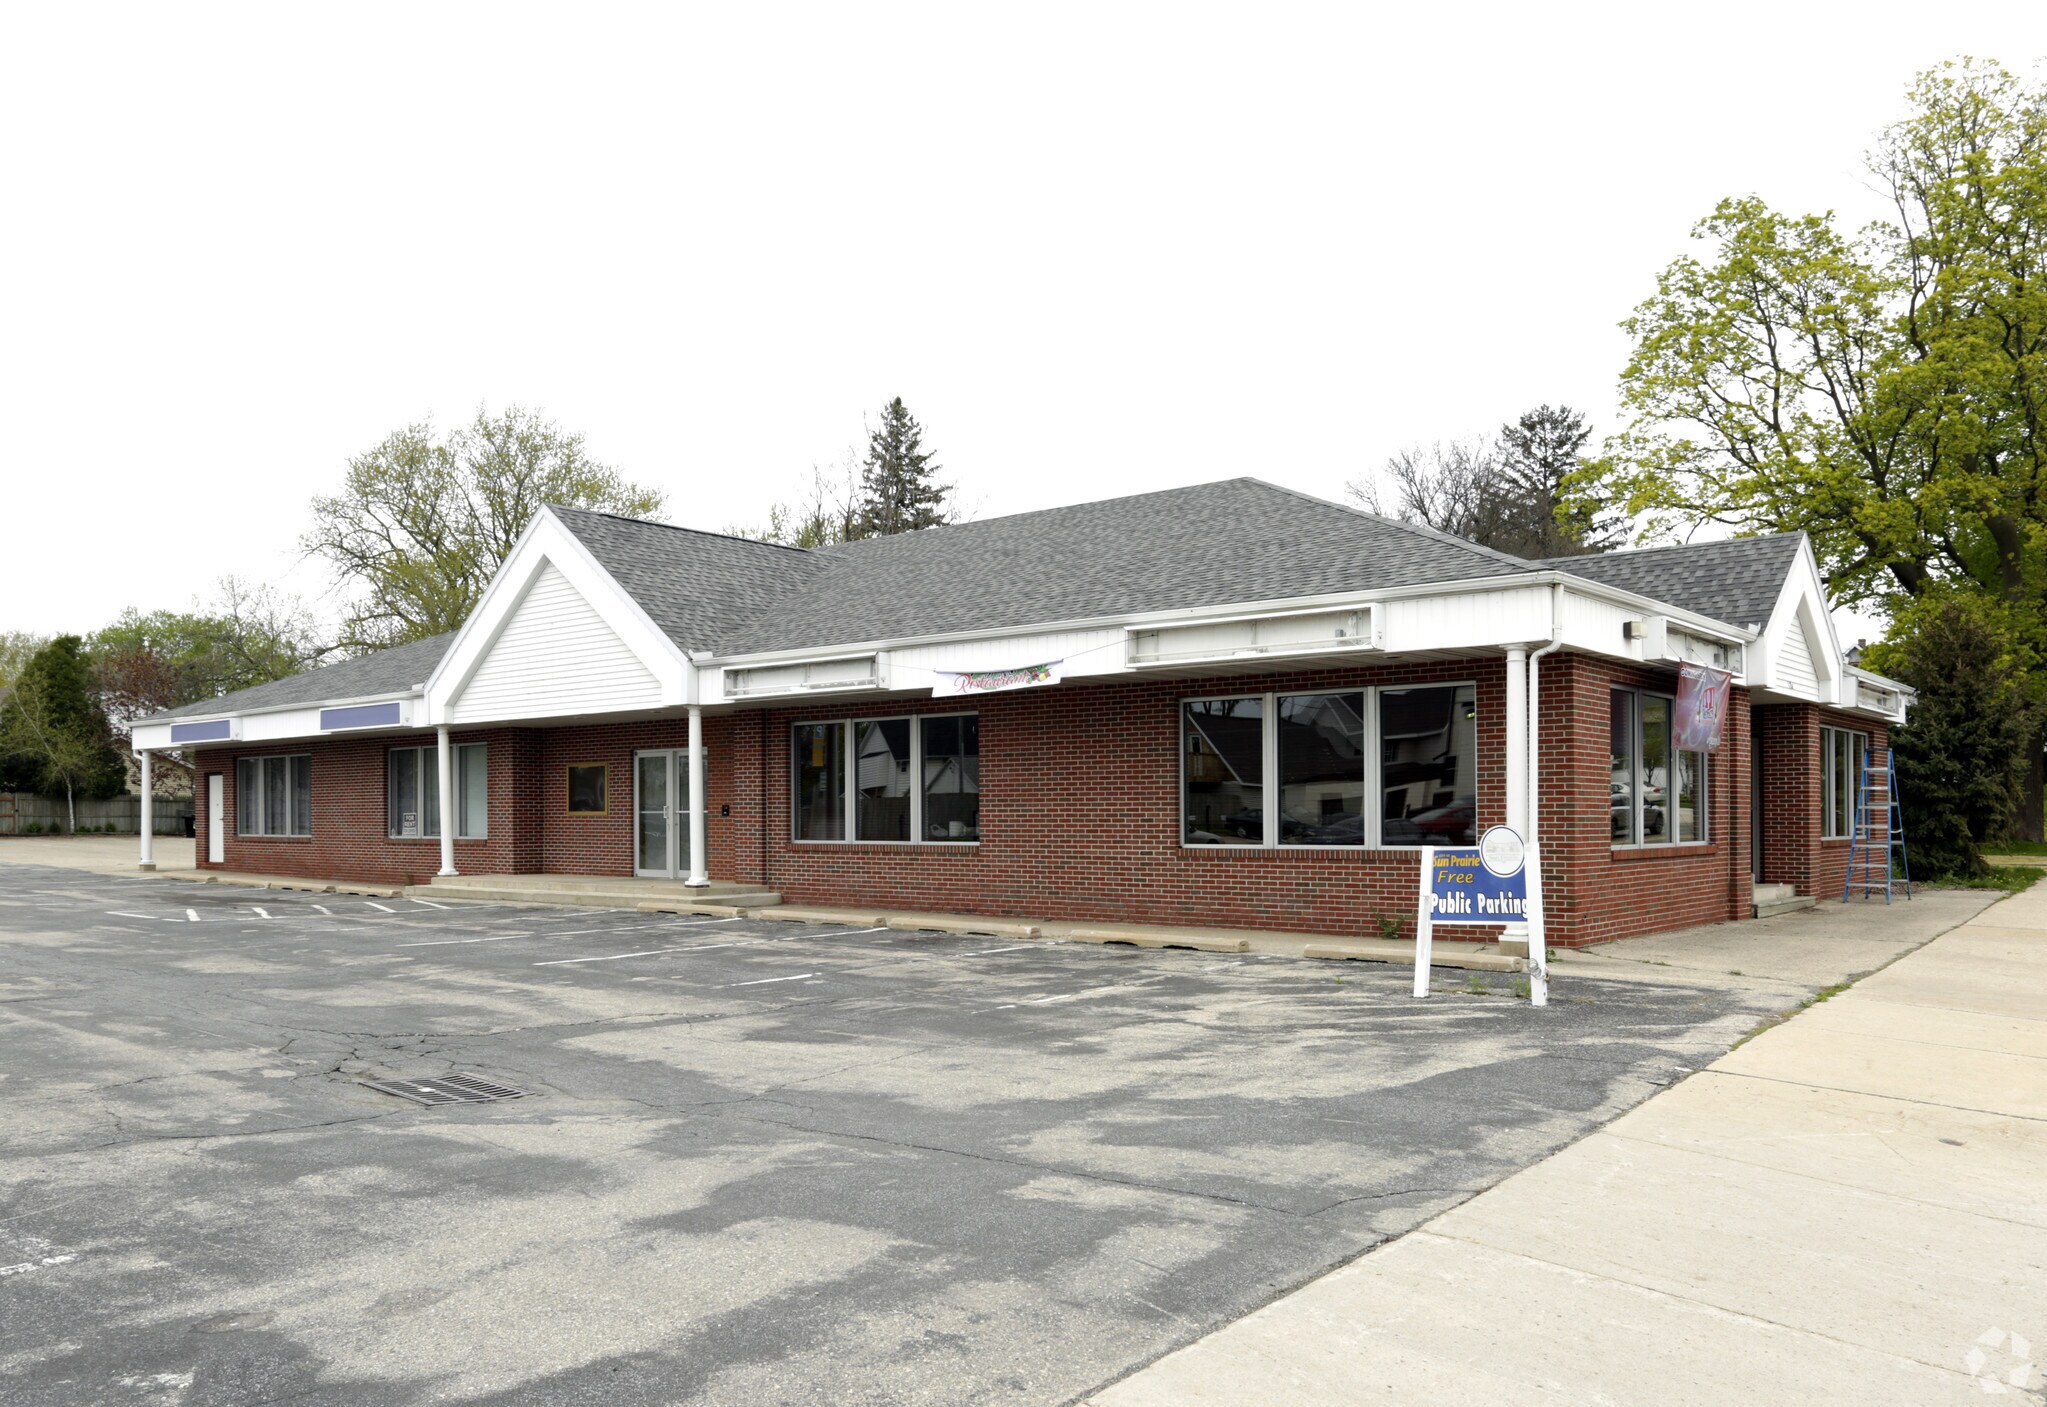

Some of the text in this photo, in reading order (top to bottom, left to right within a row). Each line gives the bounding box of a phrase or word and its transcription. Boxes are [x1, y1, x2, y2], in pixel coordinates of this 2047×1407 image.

[954, 669, 1028, 693] Restaurant
[1433, 854, 1480, 867] Sun Prairie
[1437, 870, 1474, 884] Free
[1431, 891, 1528, 918] Public Parking
